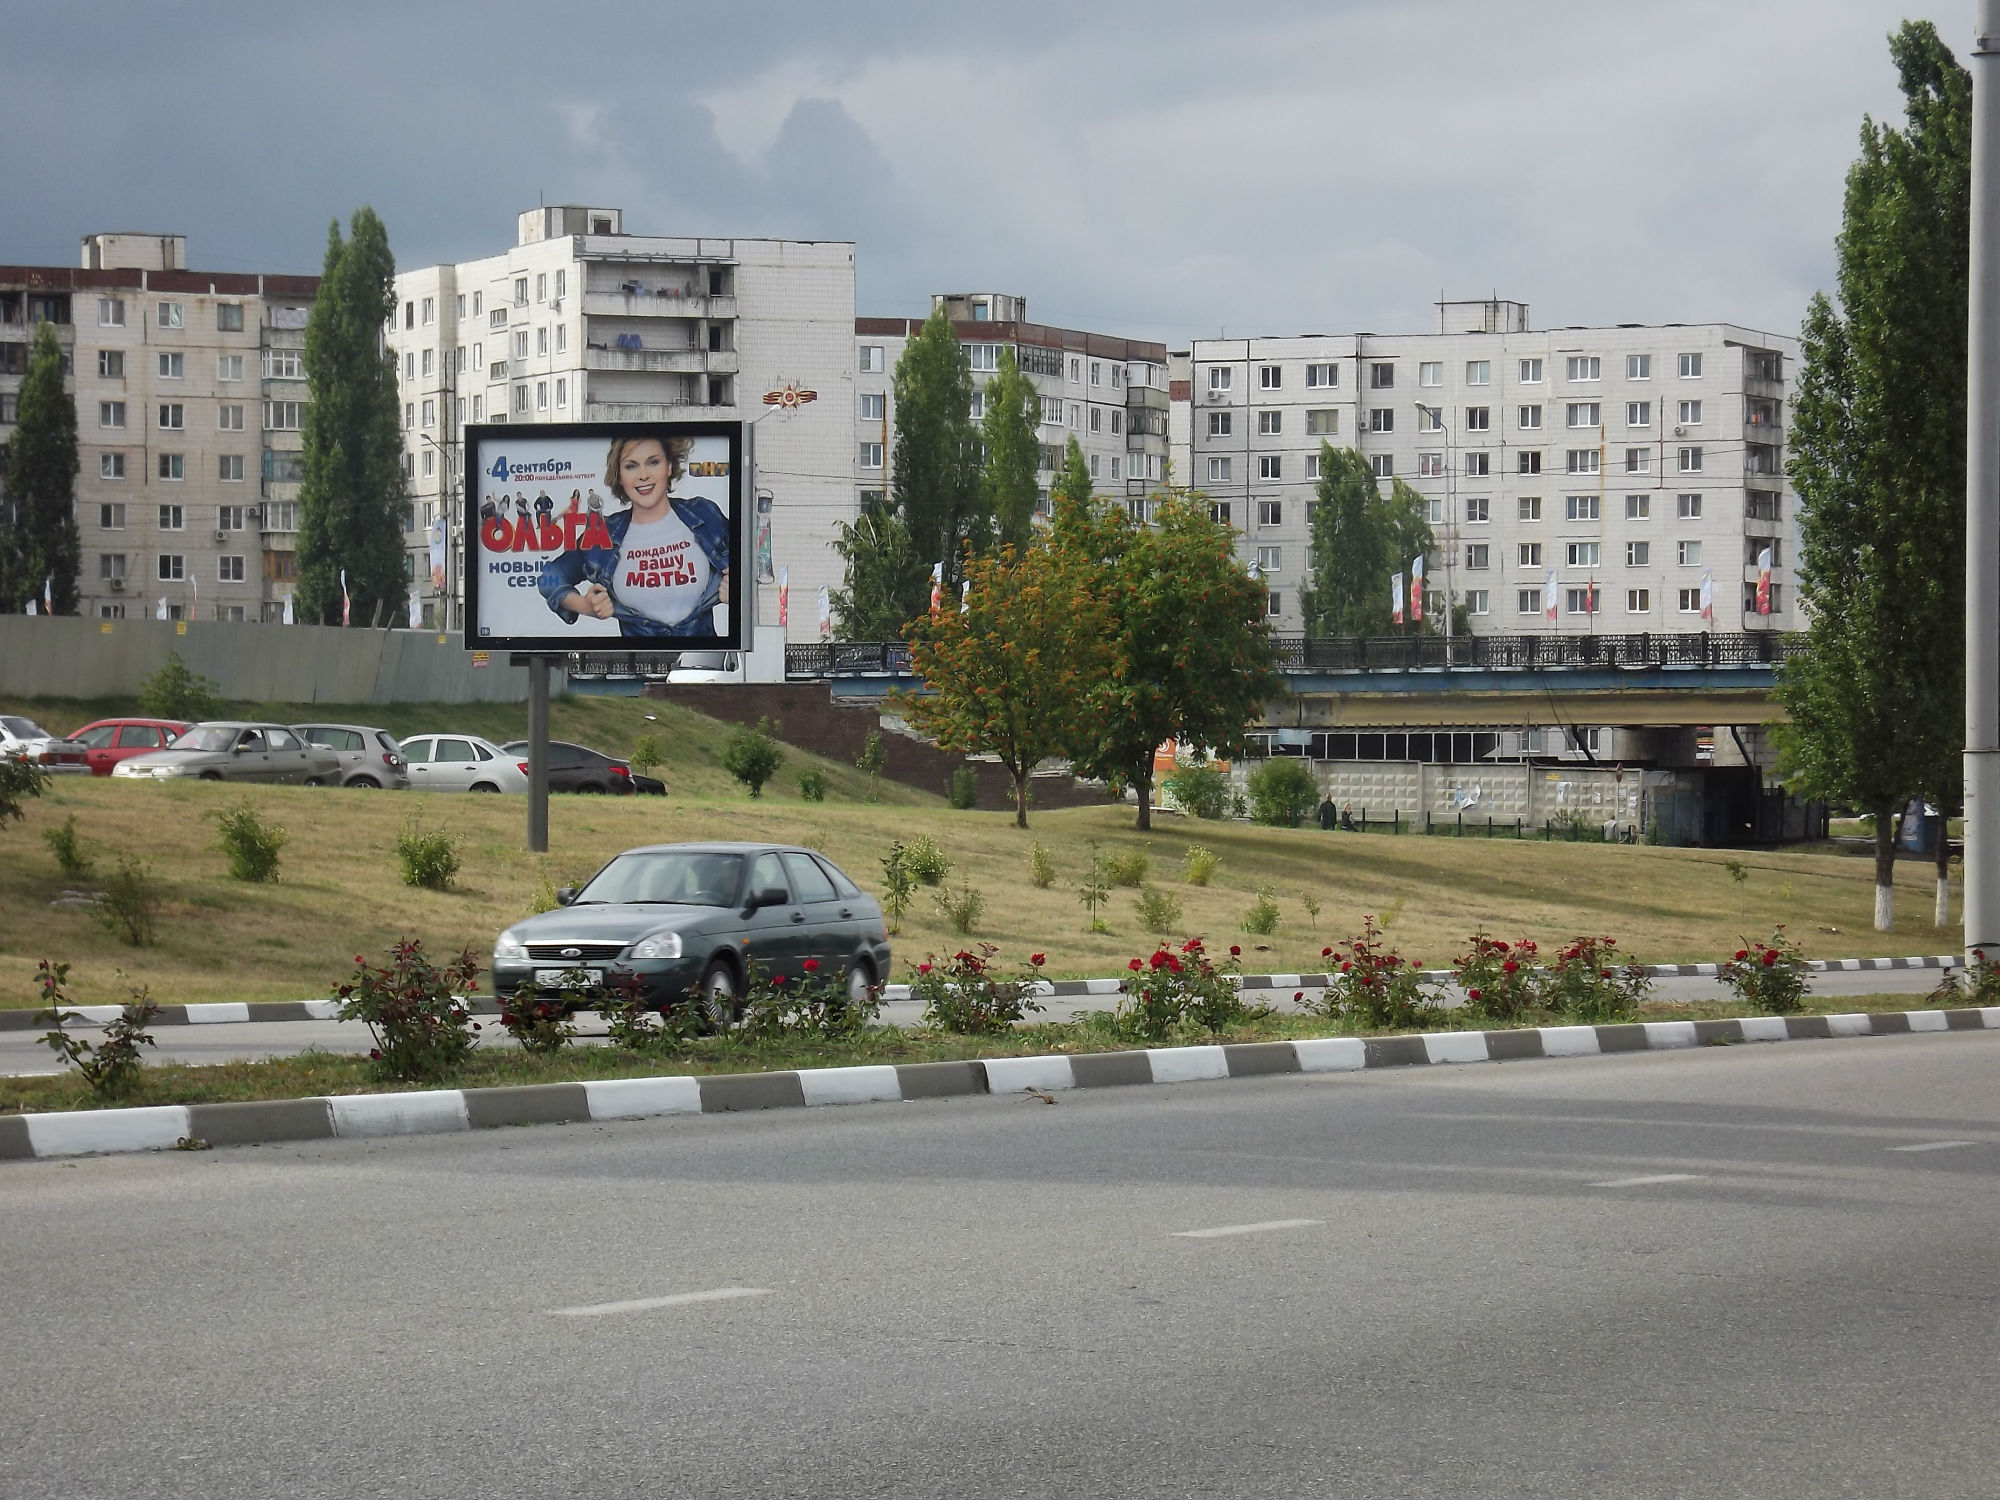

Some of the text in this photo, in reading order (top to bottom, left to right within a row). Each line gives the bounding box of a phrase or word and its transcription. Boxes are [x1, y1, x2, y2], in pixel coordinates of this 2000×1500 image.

[491, 456, 509, 482] 4
[509, 459, 572, 474] сентября
[480, 512, 613, 553] ОЛЬГА
[627, 541, 691, 560] дождались
[489, 556, 551, 573] новый
[639, 554, 684, 571] вашу
[507, 576, 559, 587] сезон
[626, 562, 697, 588] мать!
